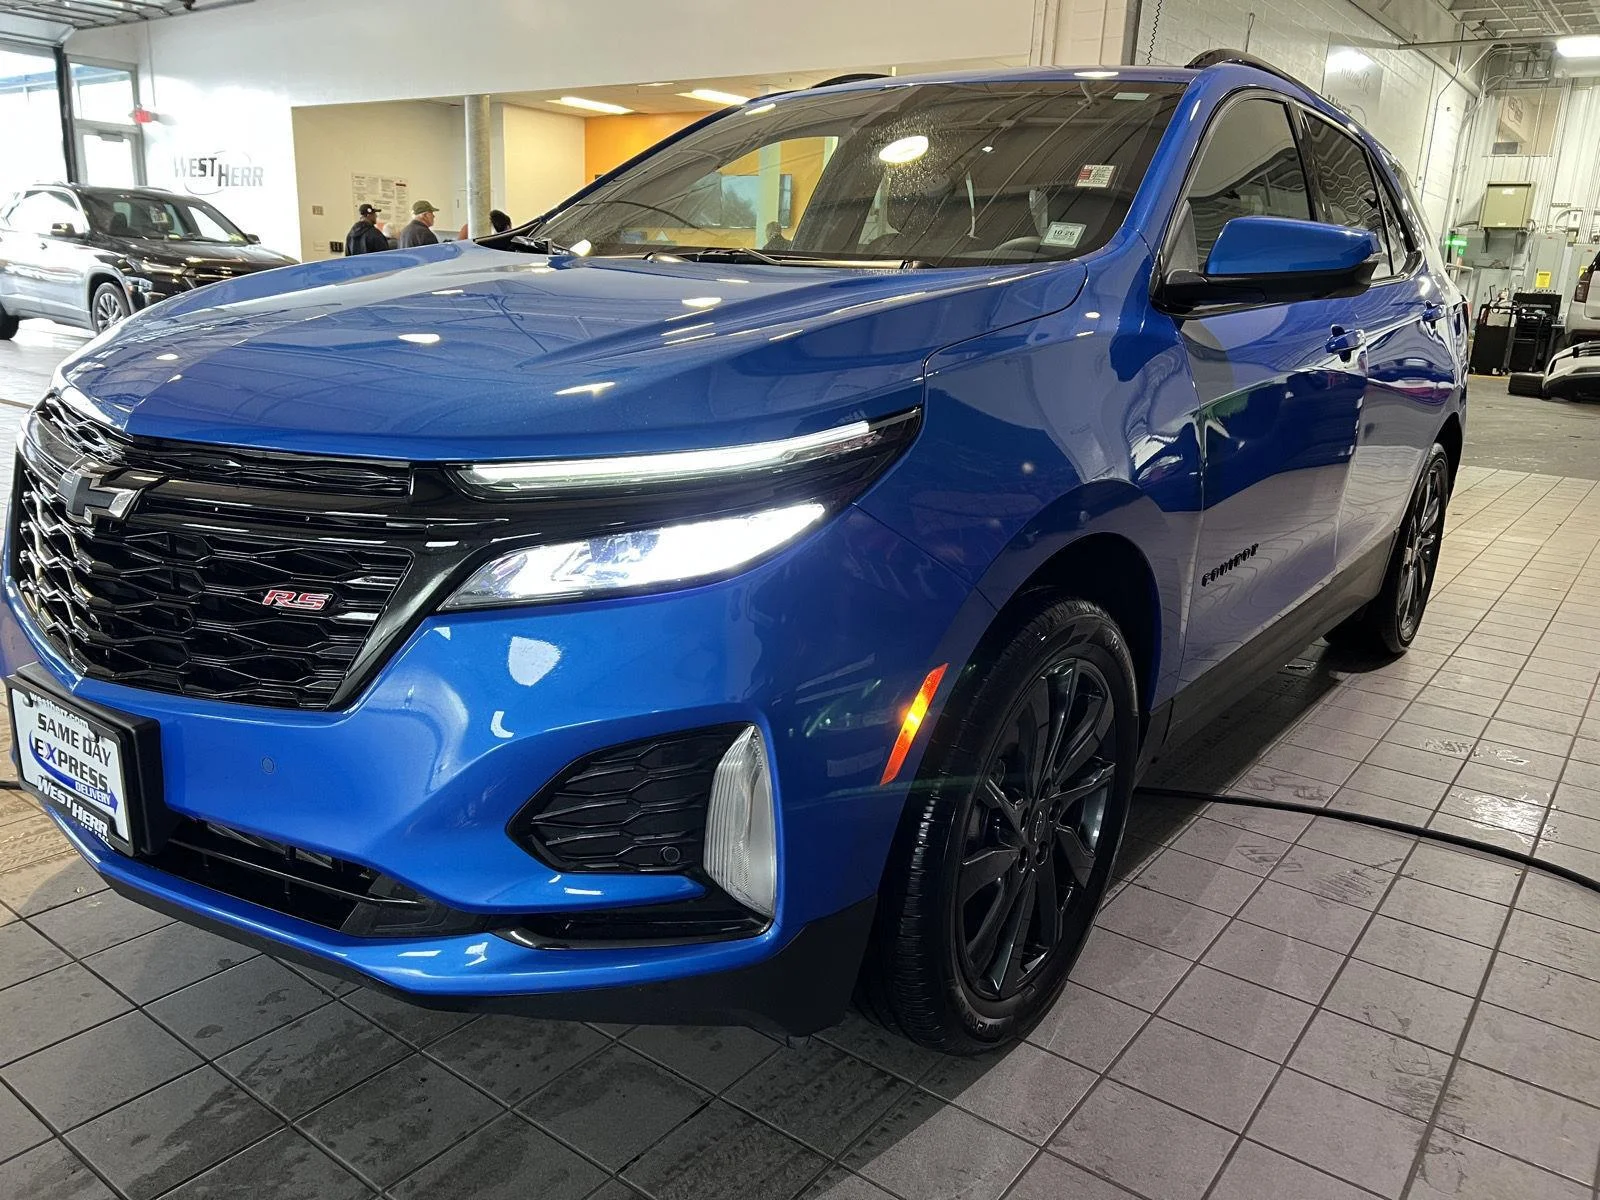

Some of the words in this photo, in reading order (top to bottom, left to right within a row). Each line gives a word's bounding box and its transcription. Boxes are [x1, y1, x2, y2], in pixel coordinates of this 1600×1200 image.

[173, 155, 217, 178] WEST
[217, 163, 264, 187] HERR
[262, 589, 332, 611] RS
[37, 712, 80, 750] SAME
[82, 735, 111, 768] DAY
[34, 737, 109, 793] EXPRESS
[37, 776, 74, 809] WEST
[71, 802, 108, 838] HERR
[74, 780, 111, 806] DELIVERY
